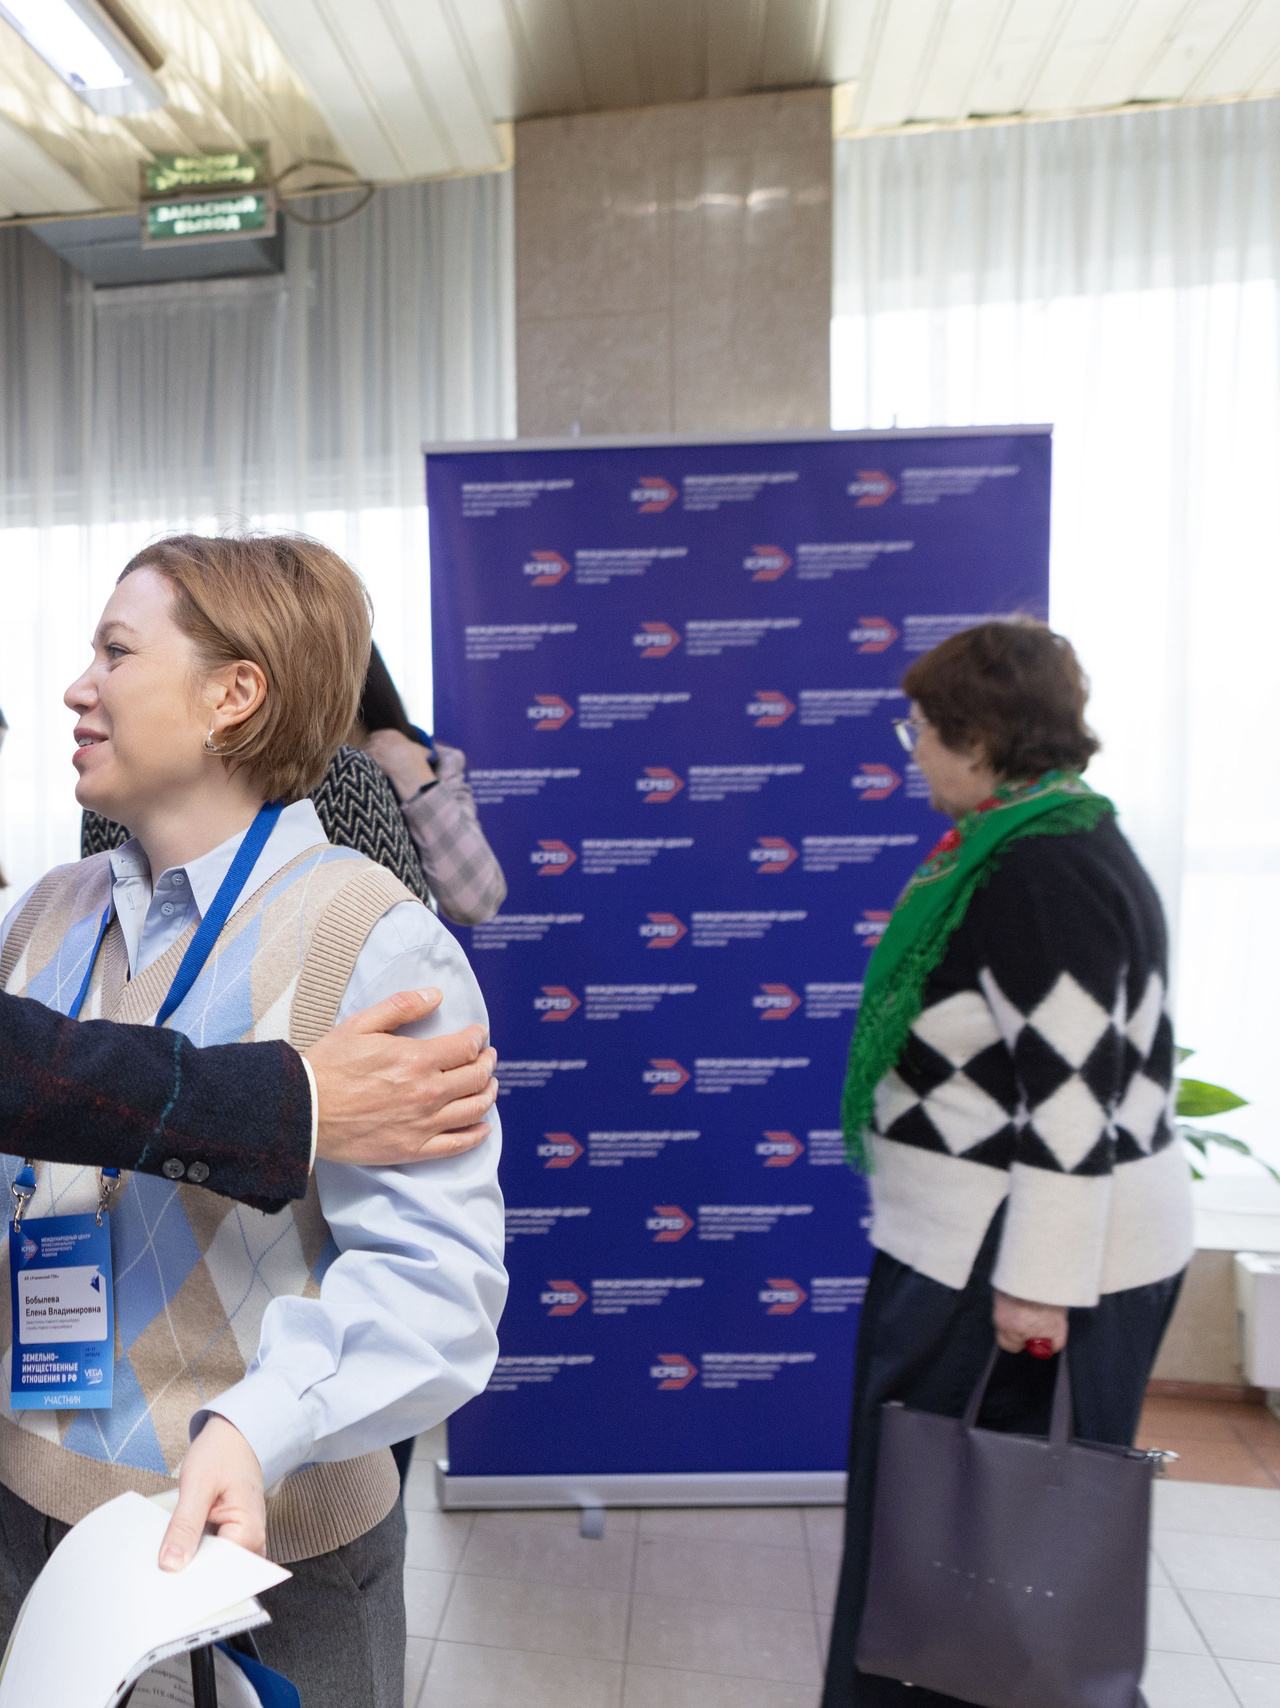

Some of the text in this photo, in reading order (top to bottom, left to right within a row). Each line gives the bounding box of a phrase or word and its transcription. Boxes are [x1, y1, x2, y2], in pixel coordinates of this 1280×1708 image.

[41, 1234, 77, 1242] МЕЖДУНАРОДНЫЙ
[26, 1296, 60, 1304] Бобылева
[26, 1306, 101, 1317] Елена Владимировна
[22, 1352, 58, 1362] ЗЕМЕЛЬНО-
[22, 1362, 78, 1373] ИМУЩЕСТВЕННЫЕ
[84, 1368, 102, 1378] VEGA
[22, 1374, 77, 1384] ОТНОШЕНИЯ В РФ
[44, 1394, 81, 1405] УЧАСТНИК
